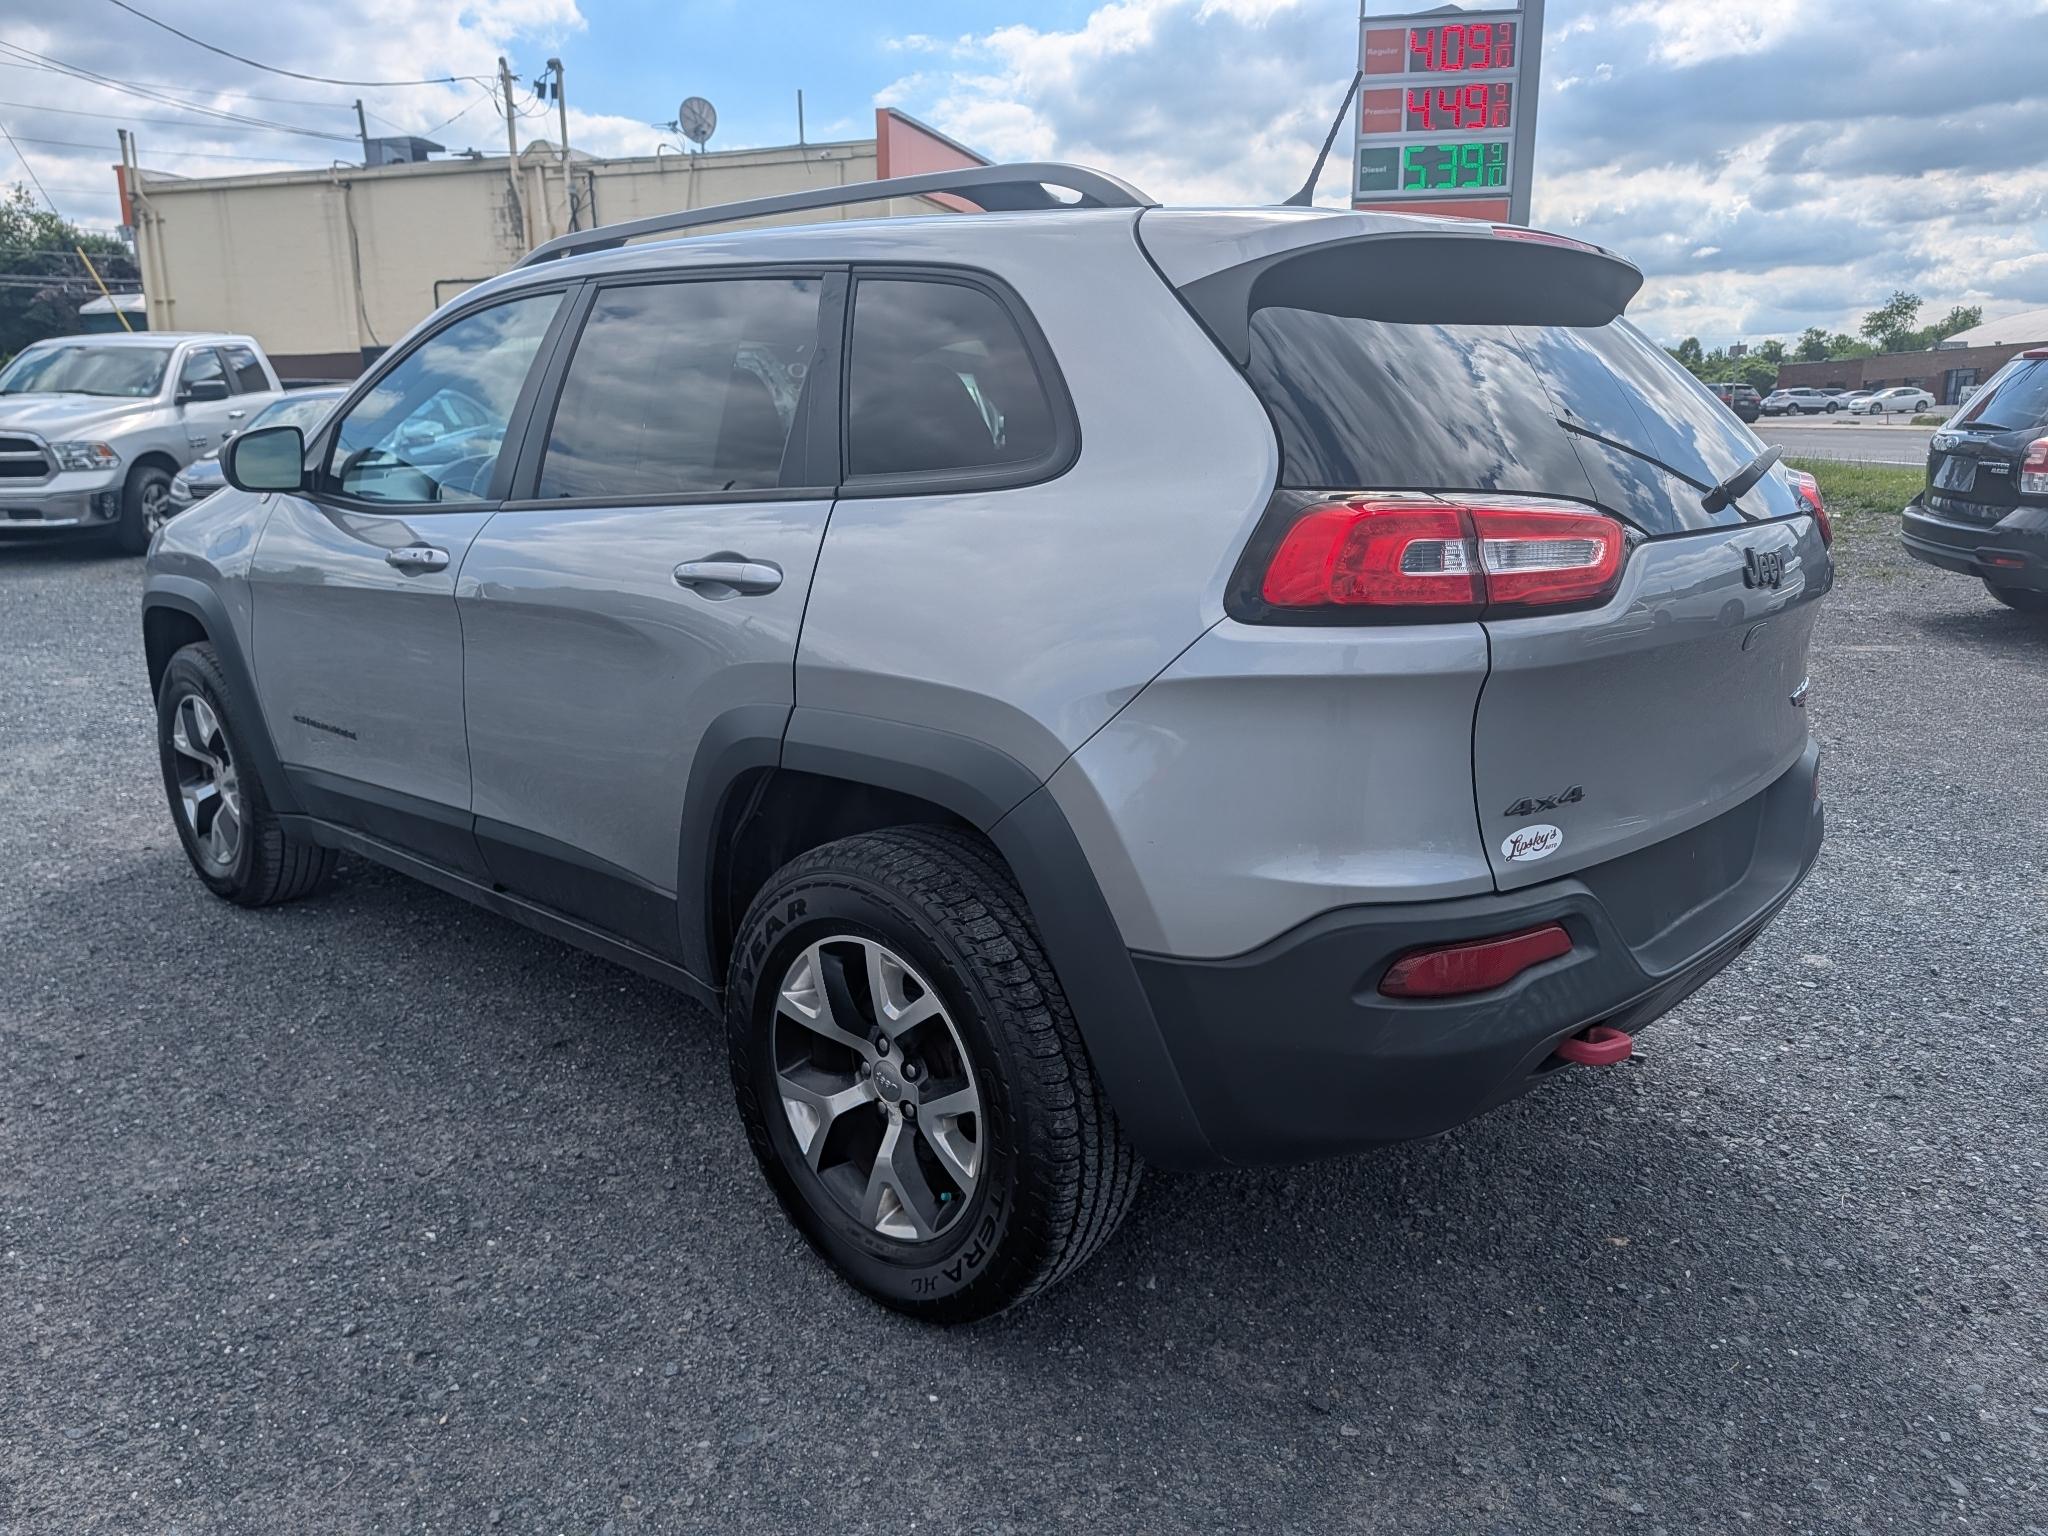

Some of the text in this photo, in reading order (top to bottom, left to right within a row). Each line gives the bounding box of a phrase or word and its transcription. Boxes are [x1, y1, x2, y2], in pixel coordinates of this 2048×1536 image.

[1410, 24, 1492, 71] 4.09
[1408, 84, 1488, 130] 4.49
[1362, 143, 1485, 190] Diesel 5.39
[1743, 547, 1786, 590] Jeep
[1505, 829, 1557, 862] Lipsky's
